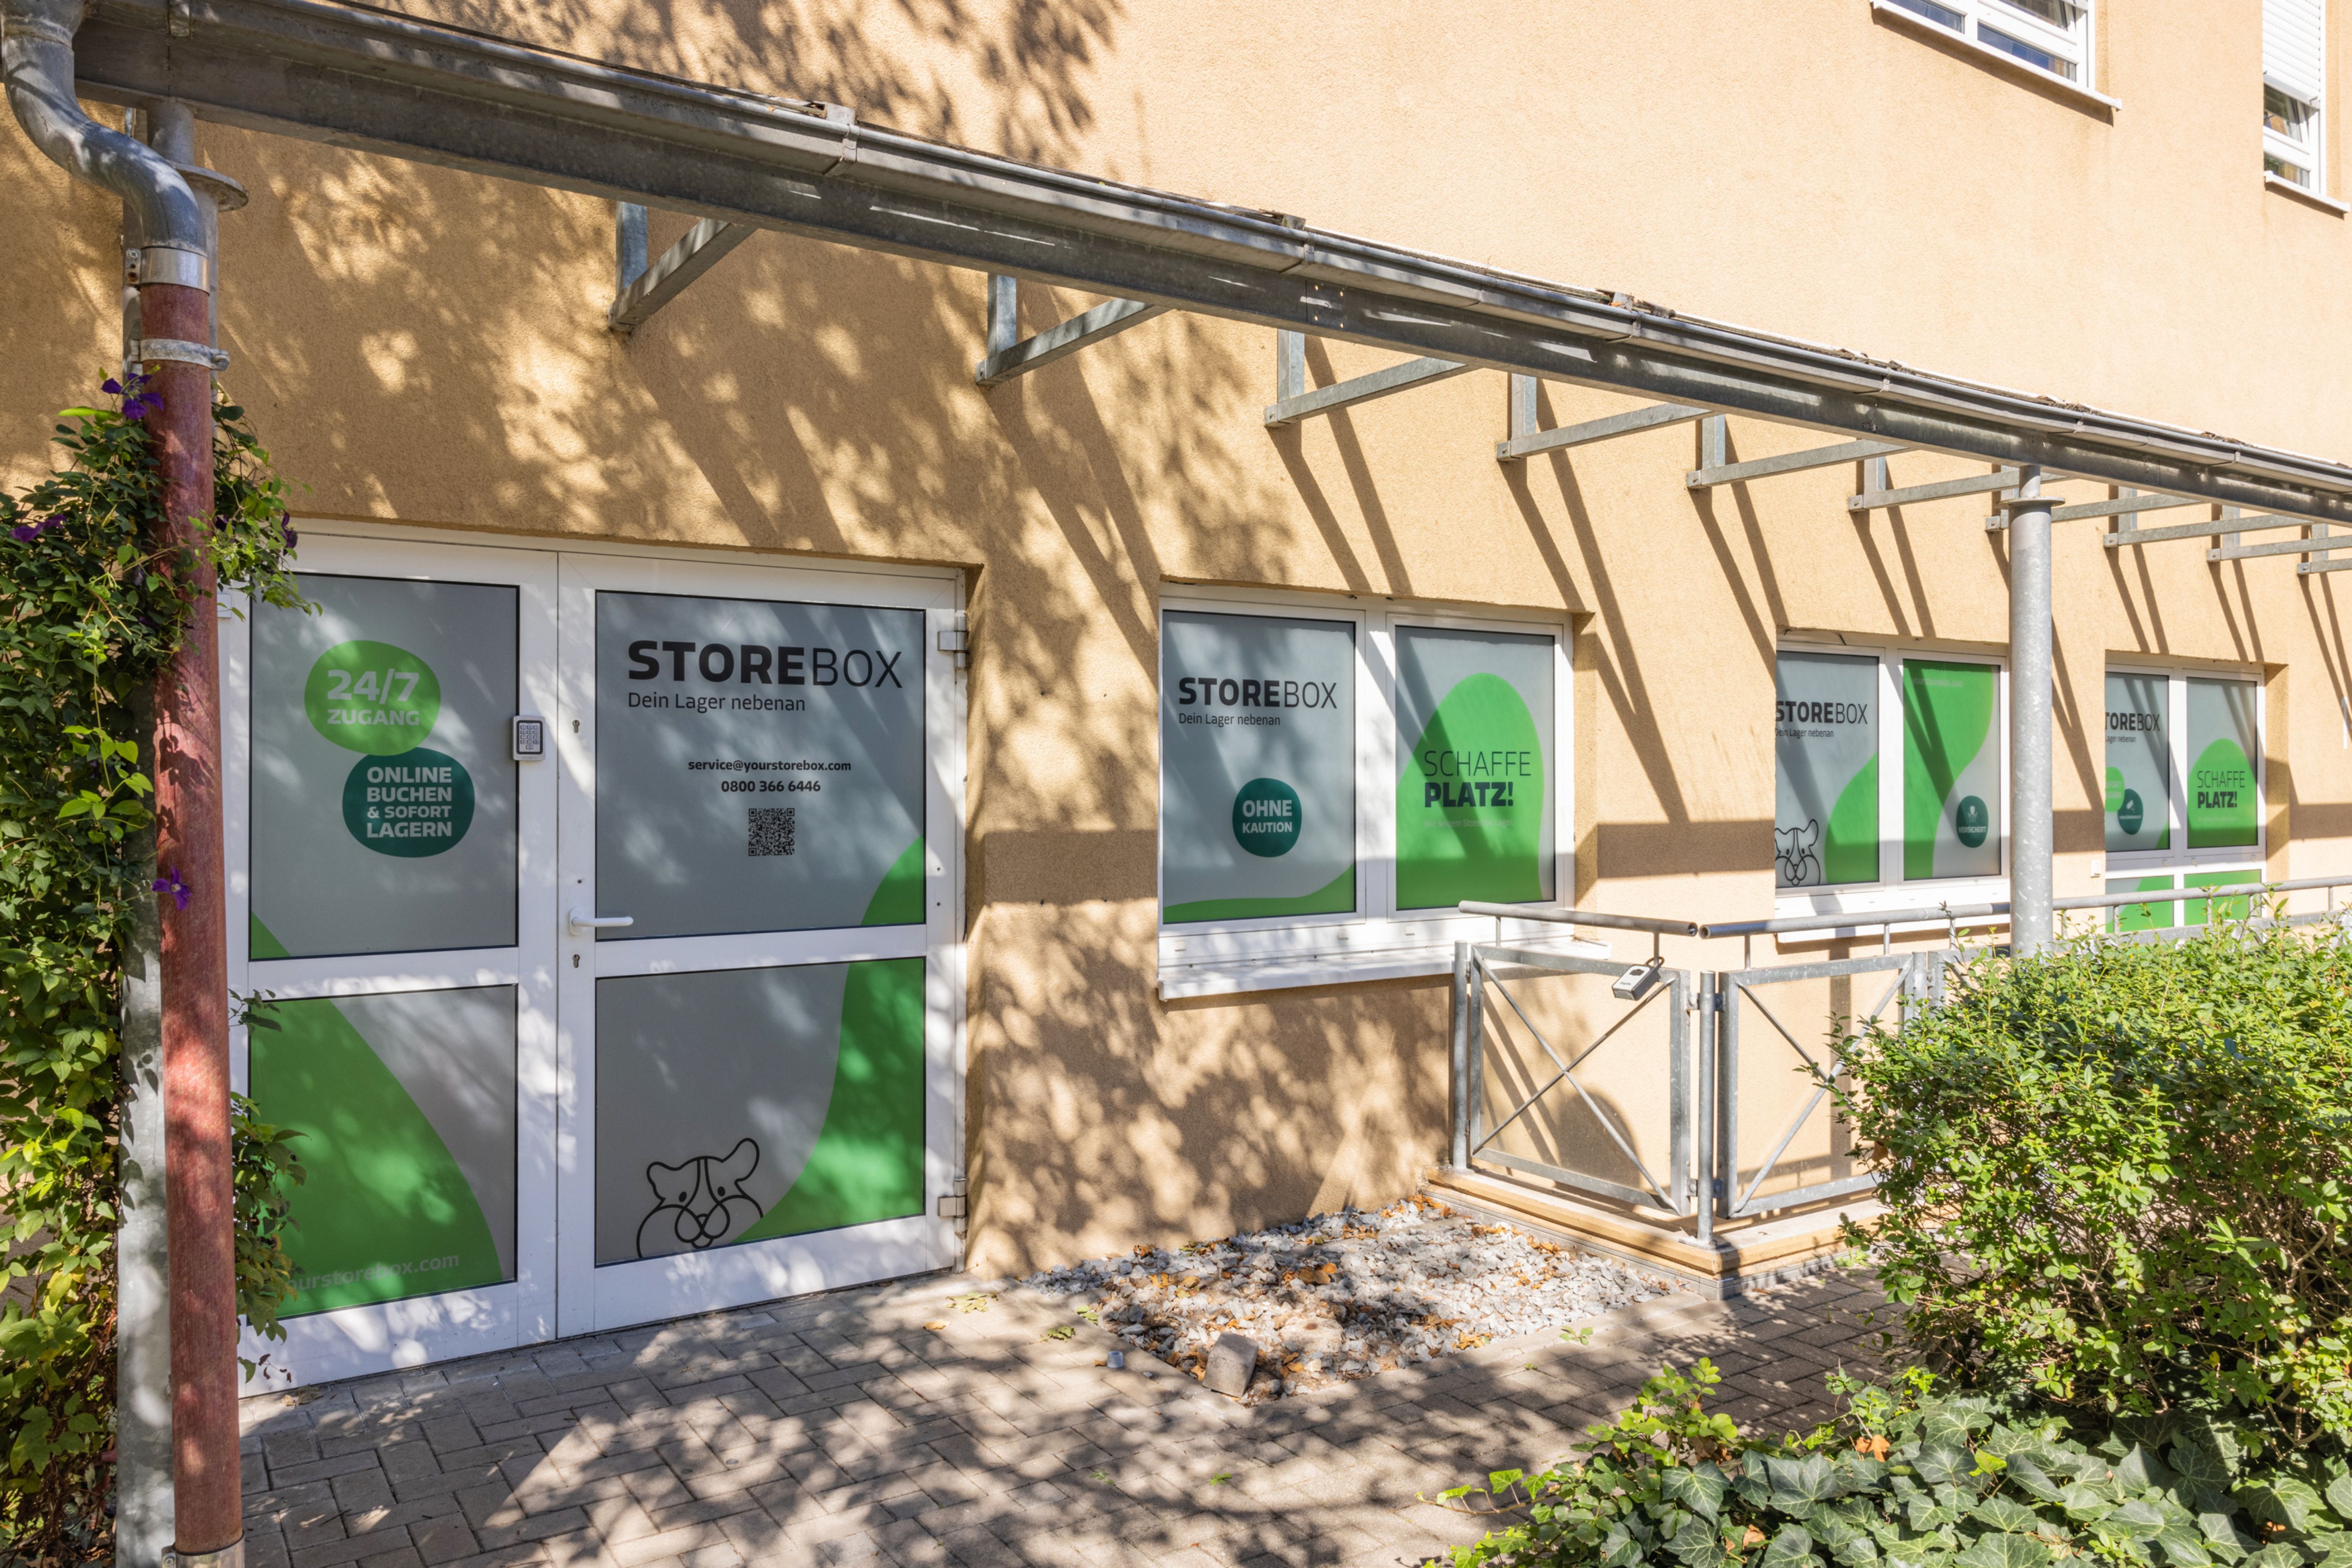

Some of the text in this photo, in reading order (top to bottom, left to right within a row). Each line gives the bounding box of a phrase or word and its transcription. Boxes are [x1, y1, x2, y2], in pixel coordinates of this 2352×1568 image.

[628, 640, 903, 689] STOREBOX
[327, 668, 420, 705] 24/7
[1178, 677, 1338, 709] STOREBOX
[629, 692, 805, 713] Dein Lager nebenan
[327, 709, 420, 726] ZUGANG
[1179, 713, 1281, 728] Dein Lager nebenan
[1776, 701, 1868, 724] STOREBOX
[2106, 712, 2160, 731] TOREBOX
[1790, 728, 1807, 739] Lager
[1809, 728, 1834, 738] nebenan
[688, 759, 852, 773] service@yourstorebox.com
[1424, 750, 1532, 777] SCHAFFE
[366, 767, 452, 784] ONLINE
[2197, 770, 2245, 788] SCHAFFE
[366, 787, 452, 802] BUCHEN
[721, 780, 821, 793] 0800 366 6446
[1424, 781, 1514, 808] PLATZ!
[1242, 799, 1293, 817] OHNE
[2198, 791, 2238, 808] PLATZ!
[367, 805, 452, 819] & SOFORT
[366, 821, 452, 838] LAGERN
[1242, 822, 1293, 834] KAUTION
[287, 1254, 460, 1291] ourstorebox.com
